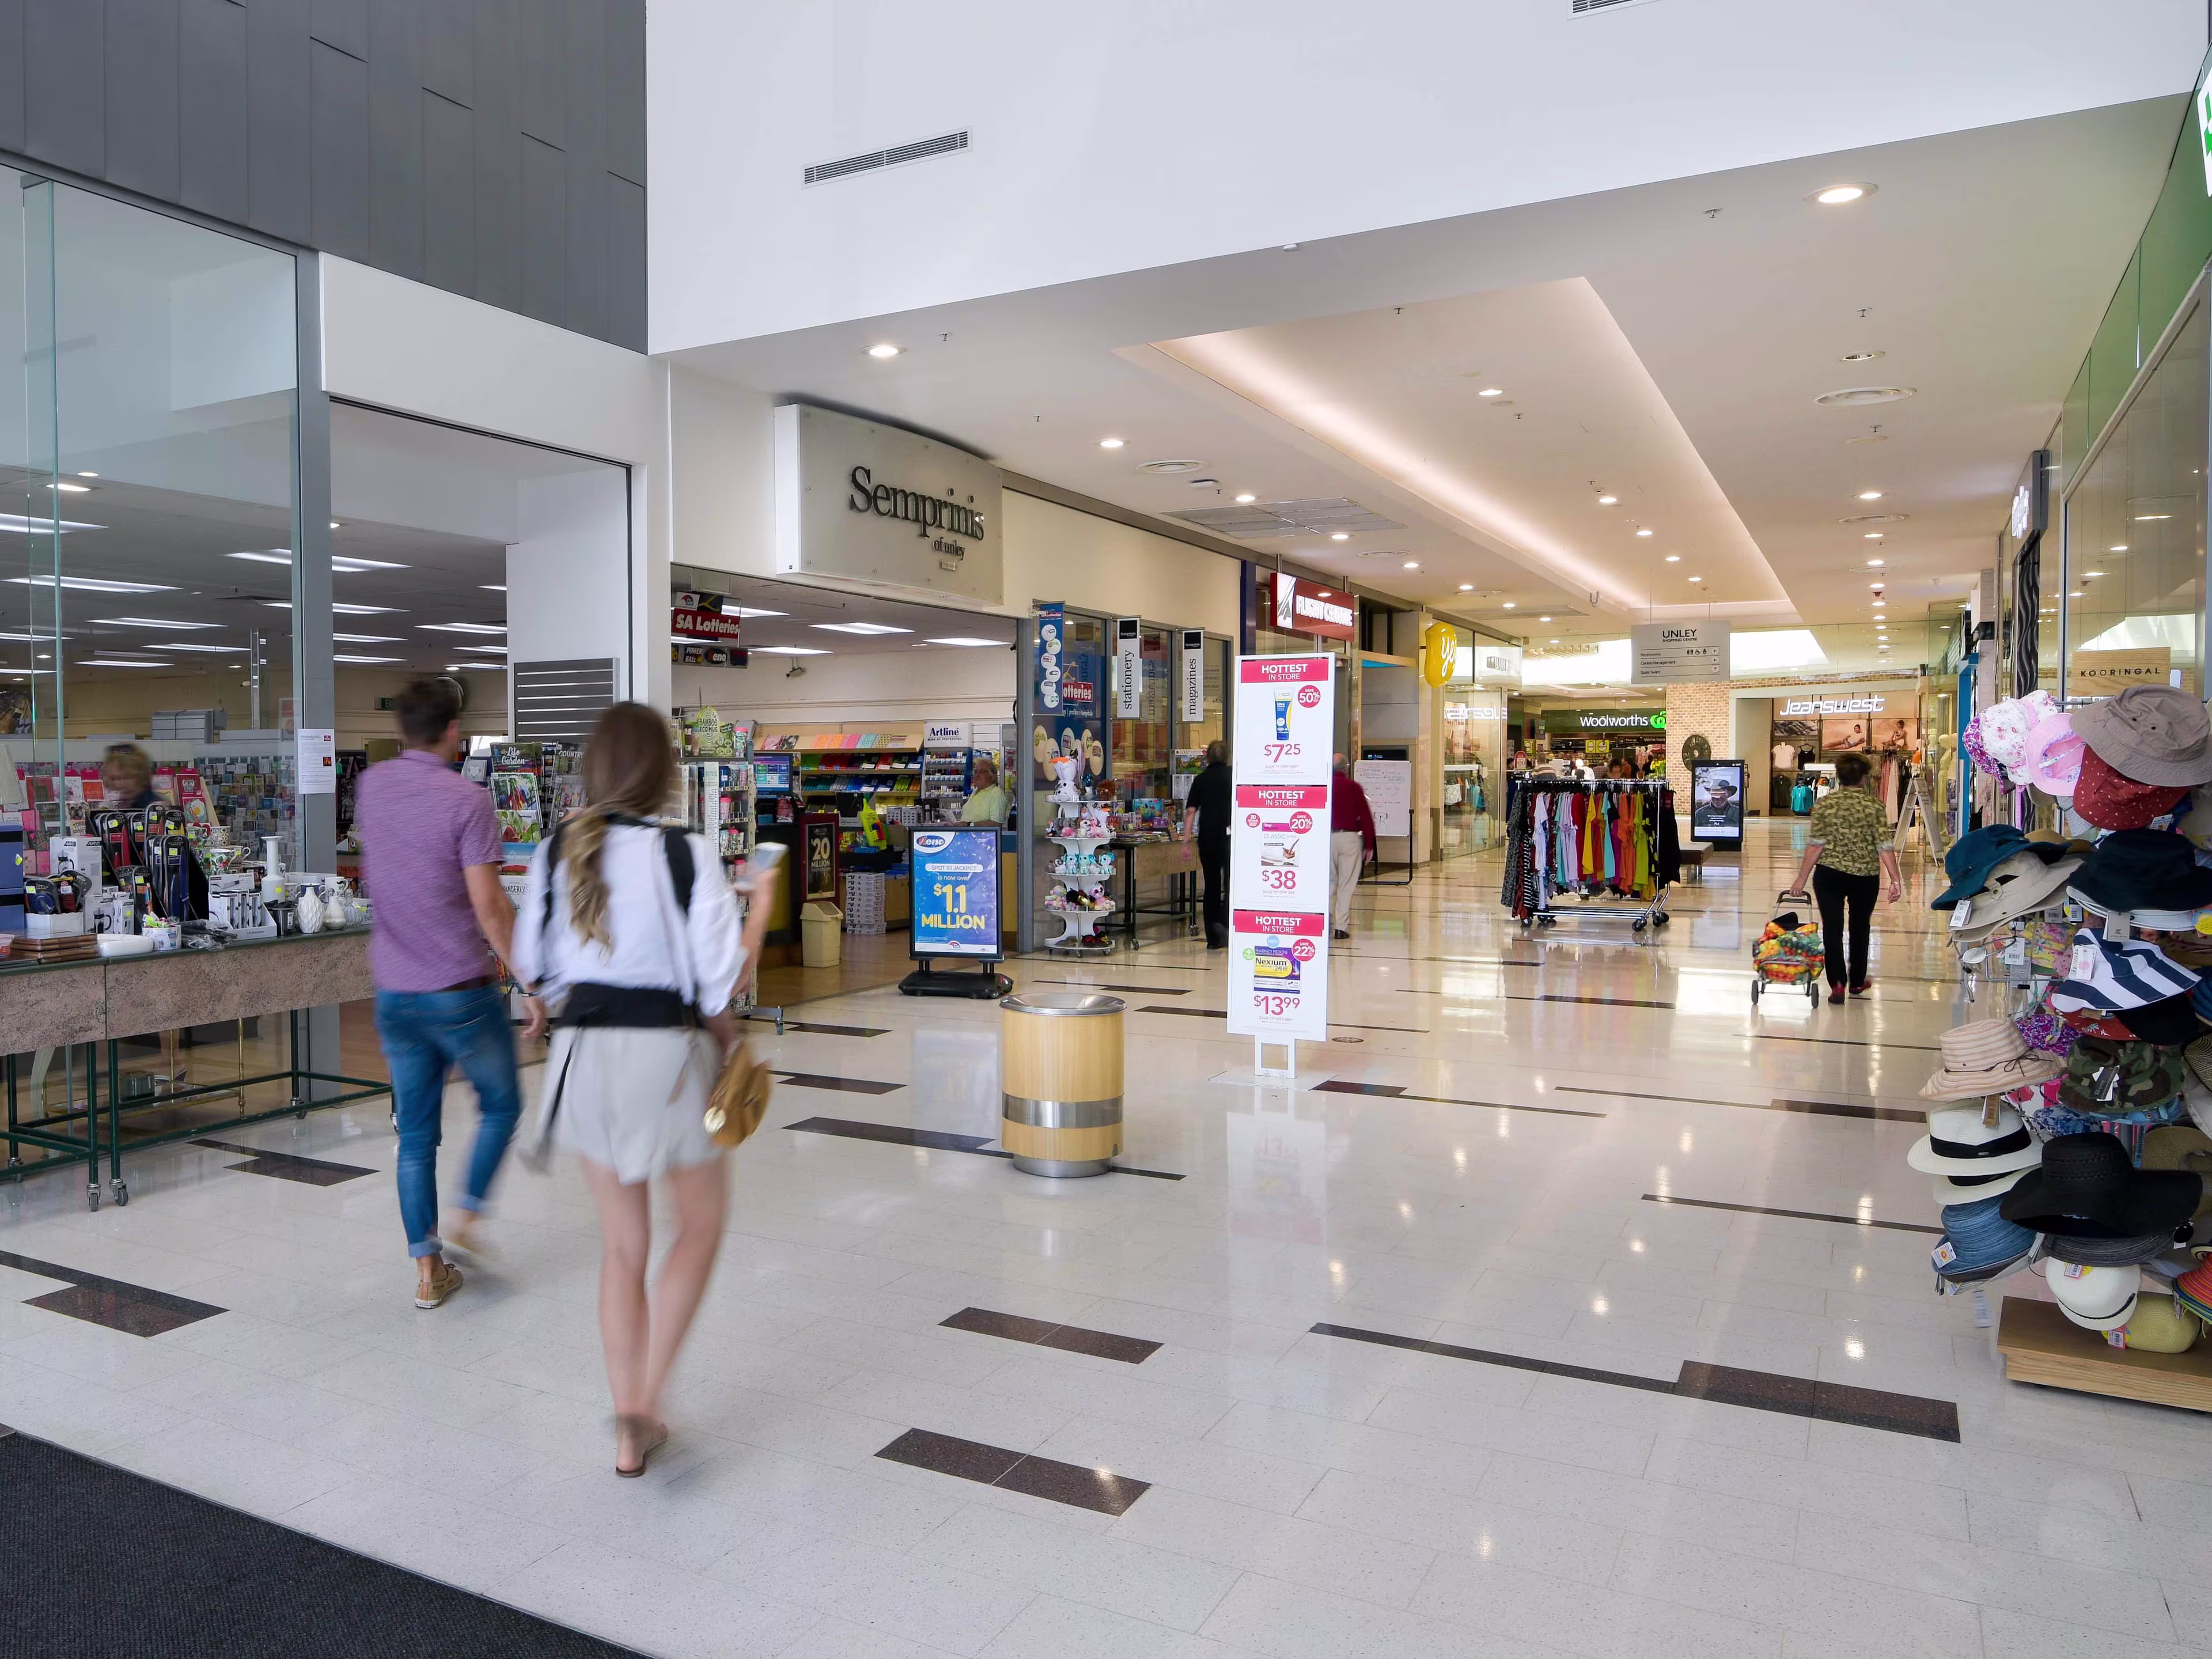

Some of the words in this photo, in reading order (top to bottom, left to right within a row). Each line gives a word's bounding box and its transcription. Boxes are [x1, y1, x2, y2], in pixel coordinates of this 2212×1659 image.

[849, 465, 984, 540] Semprinis
[1296, 594, 1325, 620] FLIGHT
[676, 614, 693, 630] SA
[696, 616, 738, 634] Lotteries
[1662, 628, 1697, 638] UNLEY
[1262, 664, 1308, 674] HOTTEST
[2081, 667, 2160, 677] KOORINGAL
[1122, 649, 1134, 710] stationery
[1187, 658, 1198, 715] magazines
[1063, 684, 1092, 700] otteries
[1300, 692, 1320, 703] 50%
[1580, 714, 1649, 727] woolworths
[930, 728, 959, 736] Artline
[506, 747, 521, 757] Life
[1259, 790, 1305, 799] HOTTEST
[1291, 819, 1312, 829] 20%
[919, 836, 945, 845] Keno
[811, 859, 830, 868] MILLION
[1262, 870, 1296, 889] $38
[933, 882, 966, 913] $1.1
[1255, 916, 1302, 926] HOTTEST
[1294, 946, 1315, 957] 22%
[1255, 958, 1287, 966] Nexium
